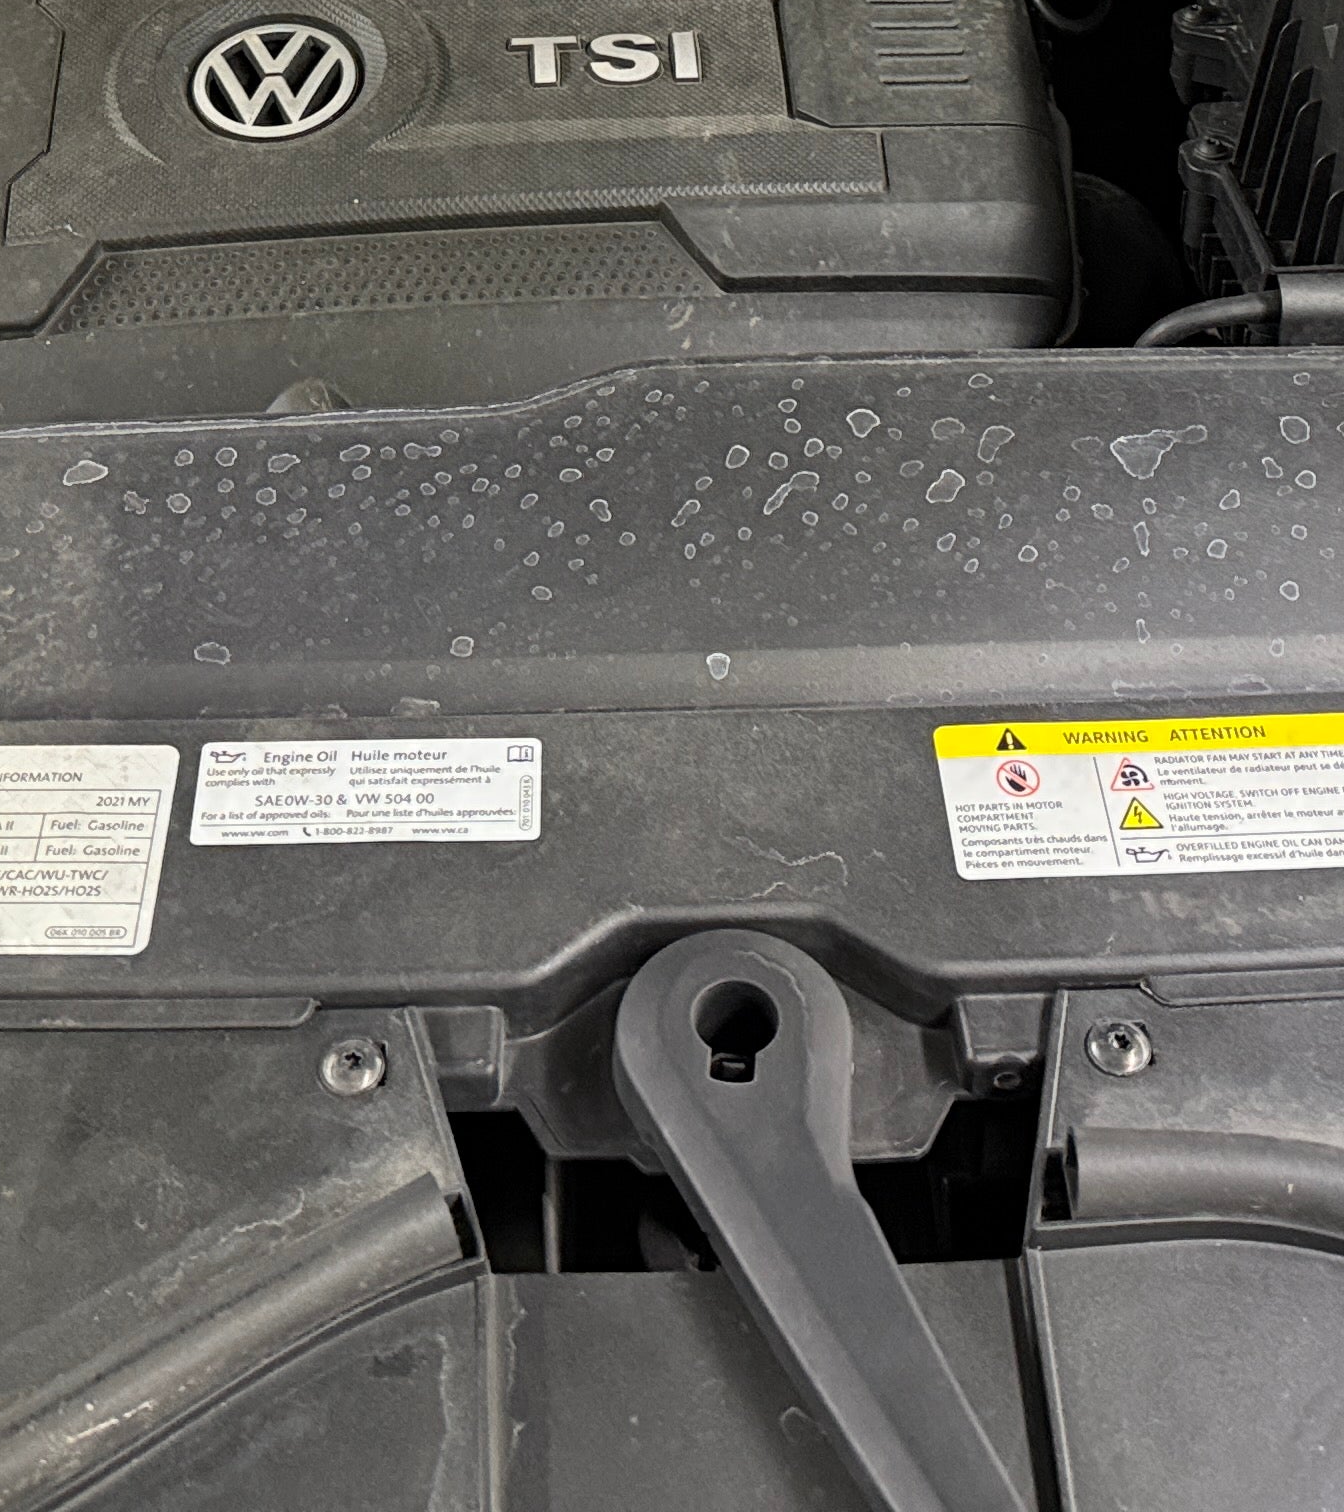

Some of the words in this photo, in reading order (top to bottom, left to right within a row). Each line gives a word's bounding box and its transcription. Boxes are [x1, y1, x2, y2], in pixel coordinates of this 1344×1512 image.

[507, 30, 703, 85] TSI
[1063, 730, 1149, 744] WARNING
[1170, 726, 1266, 741] ATTENTION
[264, 751, 313, 766] Engine
[317, 750, 337, 762] Oil
[352, 750, 389, 761] Huile
[394, 751, 447, 760] moteur
[1154, 755, 1204, 764] RADIATOR
[1252, 752, 1281, 760] START
[1285, 751, 1295, 759] AT
[207, 768, 226, 776] Use
[228, 768, 250, 777] only
[251, 767, 264, 775] oil
[266, 767, 287, 775] that
[289, 766, 336, 777] expressly
[205, 778, 250, 788] complies
[252, 778, 275, 786] with
[336, 794, 347, 805] &
[355, 793, 380, 804] VW
[384, 794, 411, 804] 504
[416, 793, 434, 804] 00
[1163, 792, 1188, 800] HIGH
[1239, 789, 1278, 798] SWITCH
[1281, 788, 1299, 796] OFF
[1302, 787, 1340, 795] ENGINE
[96, 796, 125, 807] 2021
[128, 797, 150, 806] MY
[955, 804, 975, 812] HOT
[979, 803, 1010, 811] PARTS
[1026, 801, 1063, 809] MOTOR
[1166, 801, 1211, 810] IGNITION
[201, 812, 217, 820] For
[229, 812, 244, 820] list
[246, 811, 258, 819] of
[259, 810, 308, 821] approved
[50, 820, 81, 830] Fuel:
[88, 820, 144, 831] Gasoline
[959, 824, 1001, 833] MOVING
[1176, 842, 1238, 851] OVERFILLED
[1241, 840, 1279, 849] ENGINE
[1282, 839, 1299, 847] OIL
[1301, 838, 1322, 846] CAN
[45, 845, 76, 856] Fuel:
[83, 846, 140, 856] Gasoline
